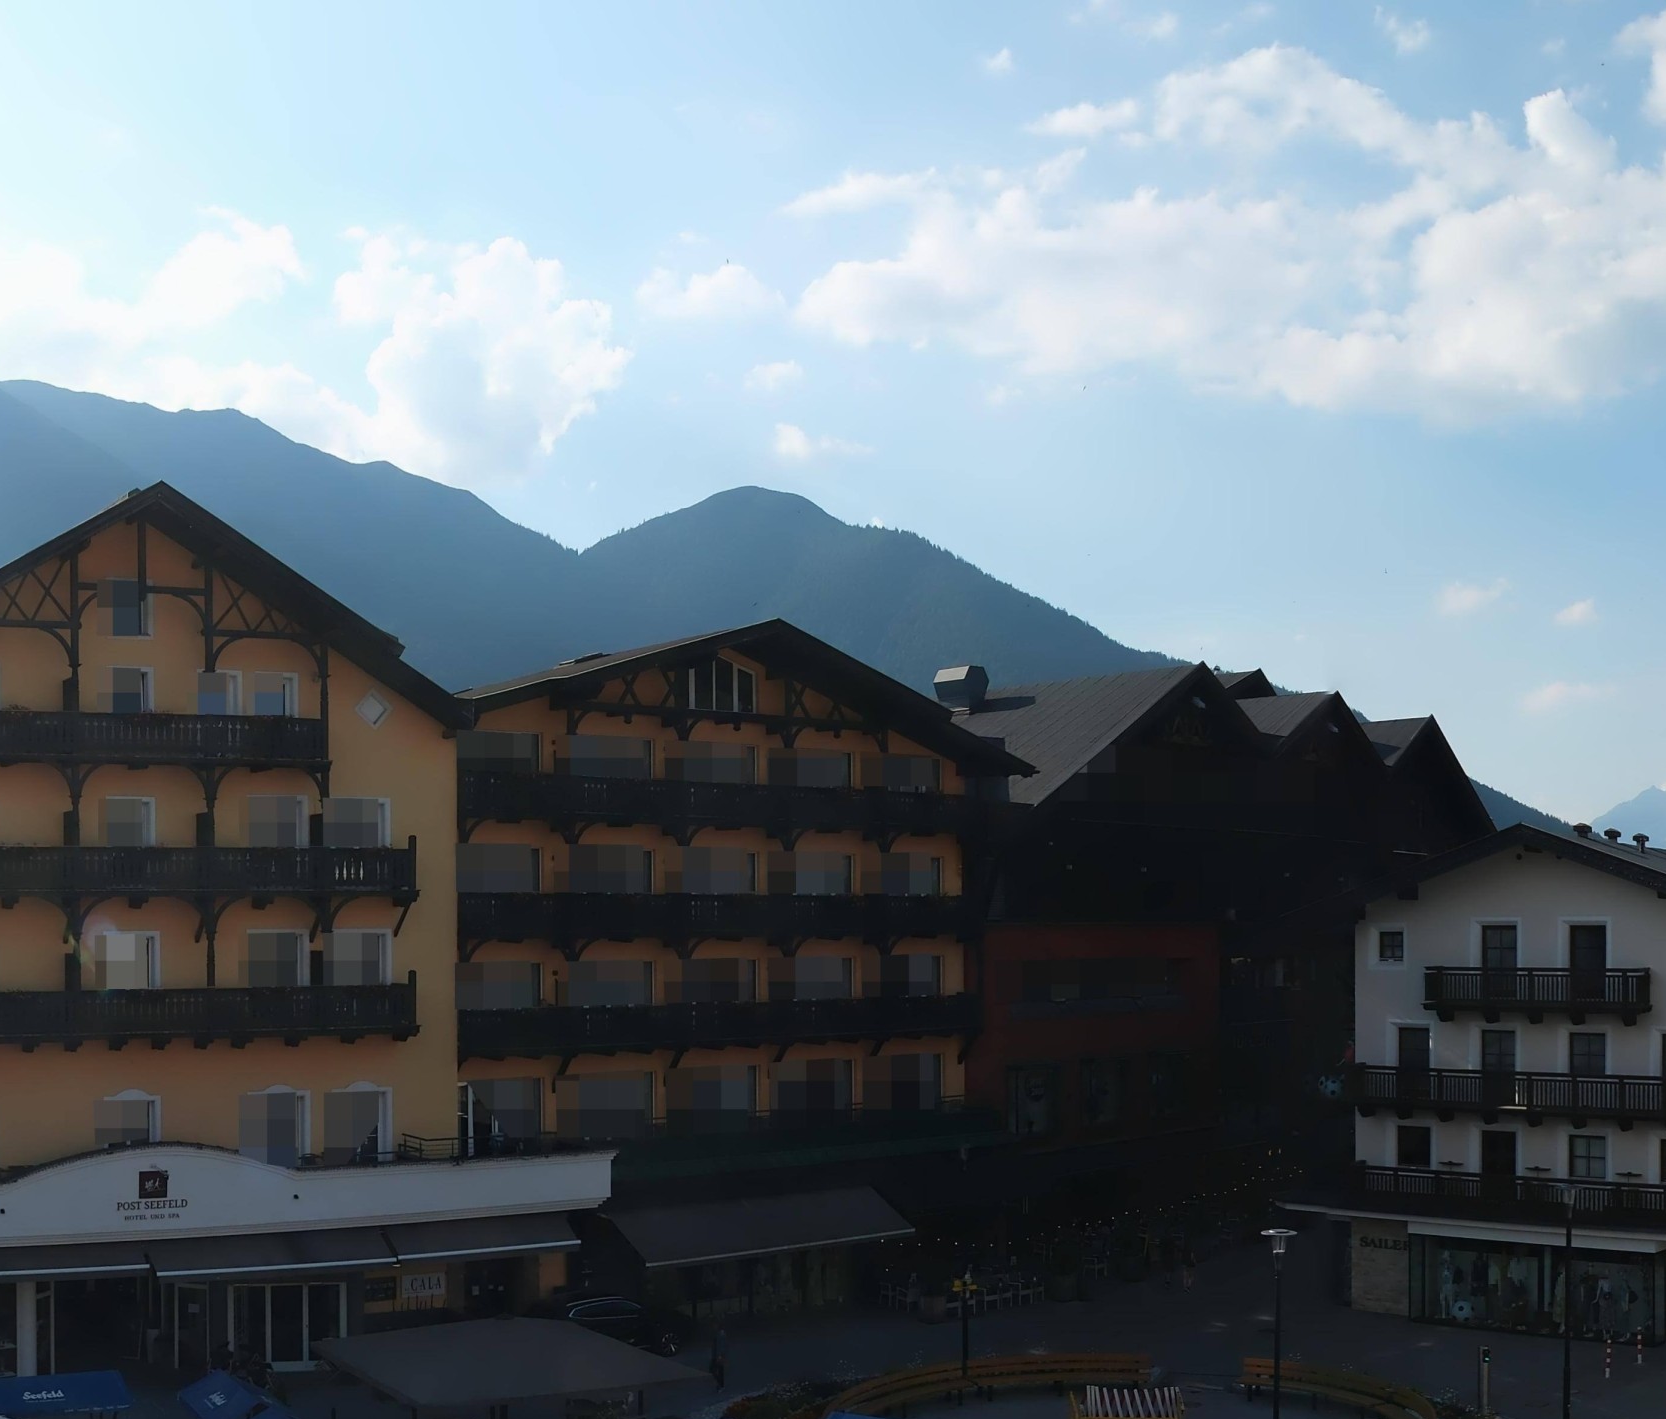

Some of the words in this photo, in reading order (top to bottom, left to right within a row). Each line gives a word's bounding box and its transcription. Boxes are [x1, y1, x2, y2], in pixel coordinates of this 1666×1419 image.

[117, 1201, 142, 1211] POST
[144, 1199, 188, 1210] SEEFELD
[23, 1389, 65, 1401] Seefeld
